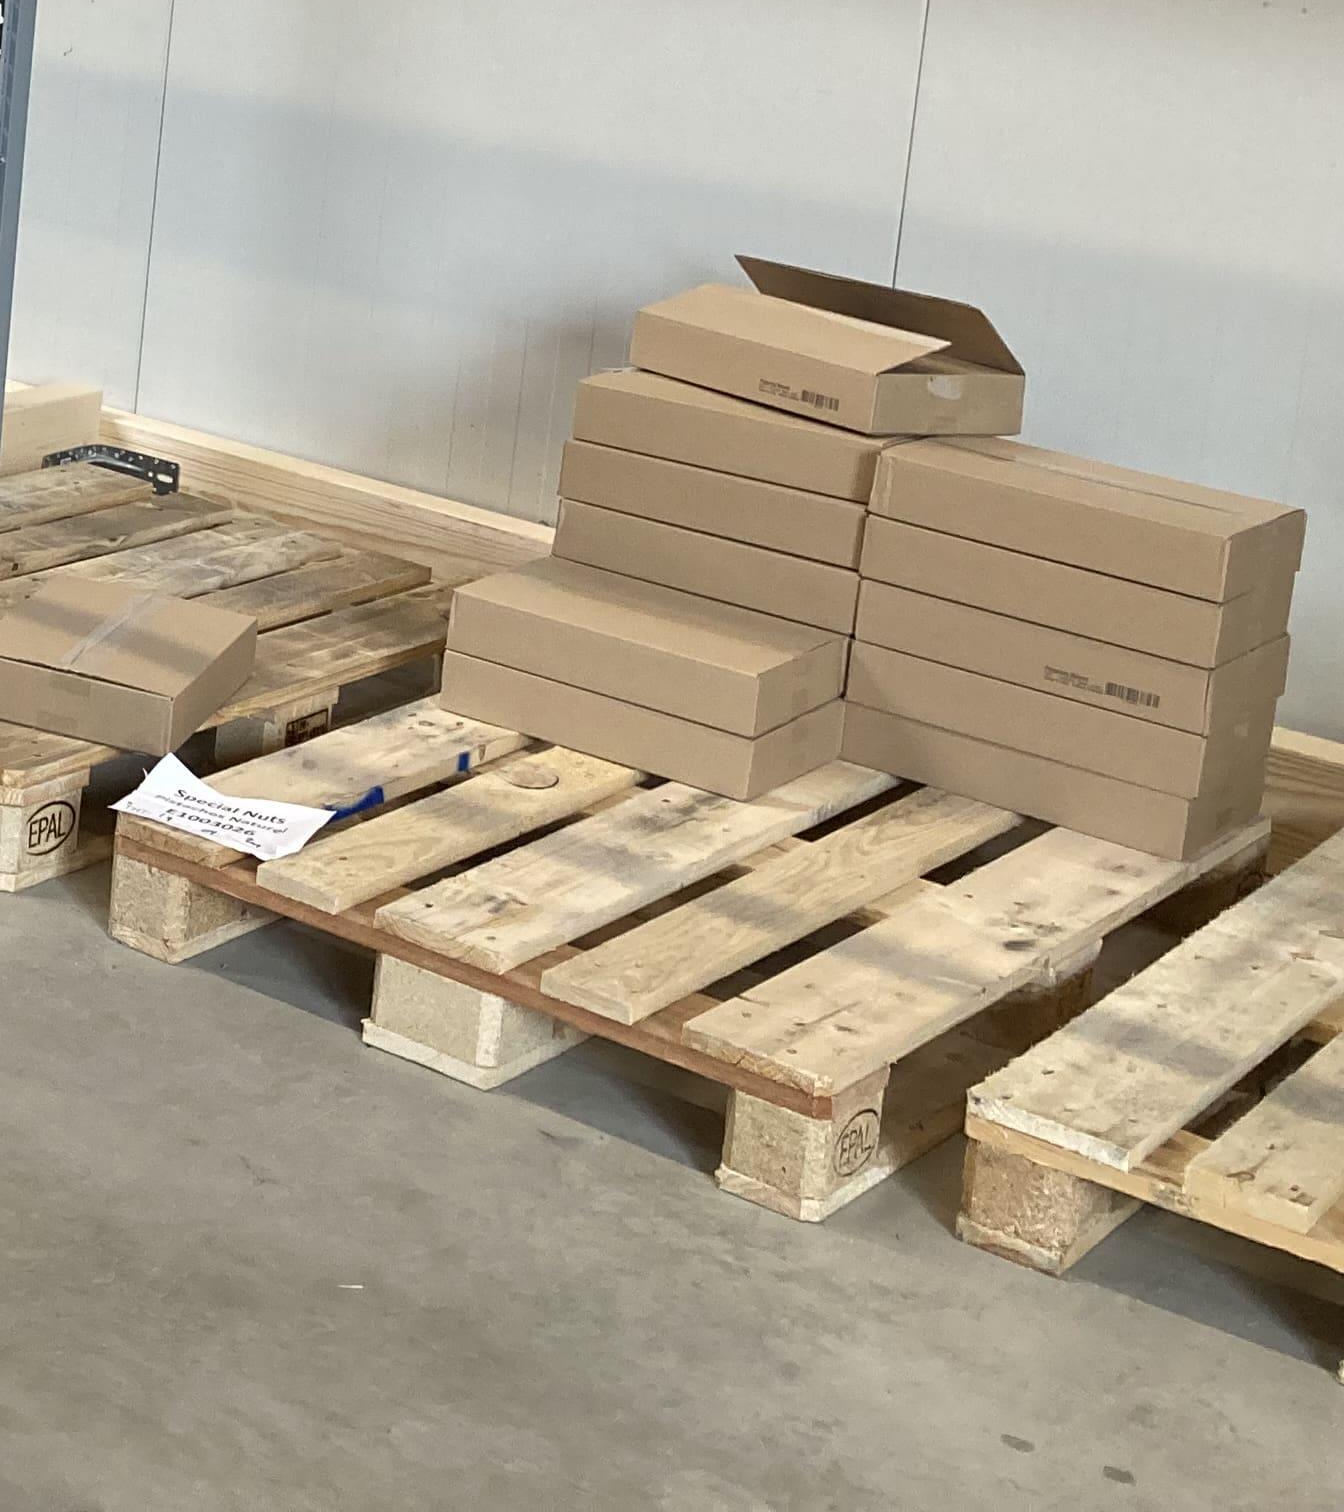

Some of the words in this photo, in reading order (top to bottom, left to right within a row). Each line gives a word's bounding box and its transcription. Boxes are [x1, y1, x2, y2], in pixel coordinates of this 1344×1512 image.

[165, 808, 255, 836] E1003026
[174, 788, 240, 814] Special
[242, 809, 287, 825] Nuts
[28, 810, 66, 849] EPAL
[228, 815, 288, 834] Naturel
